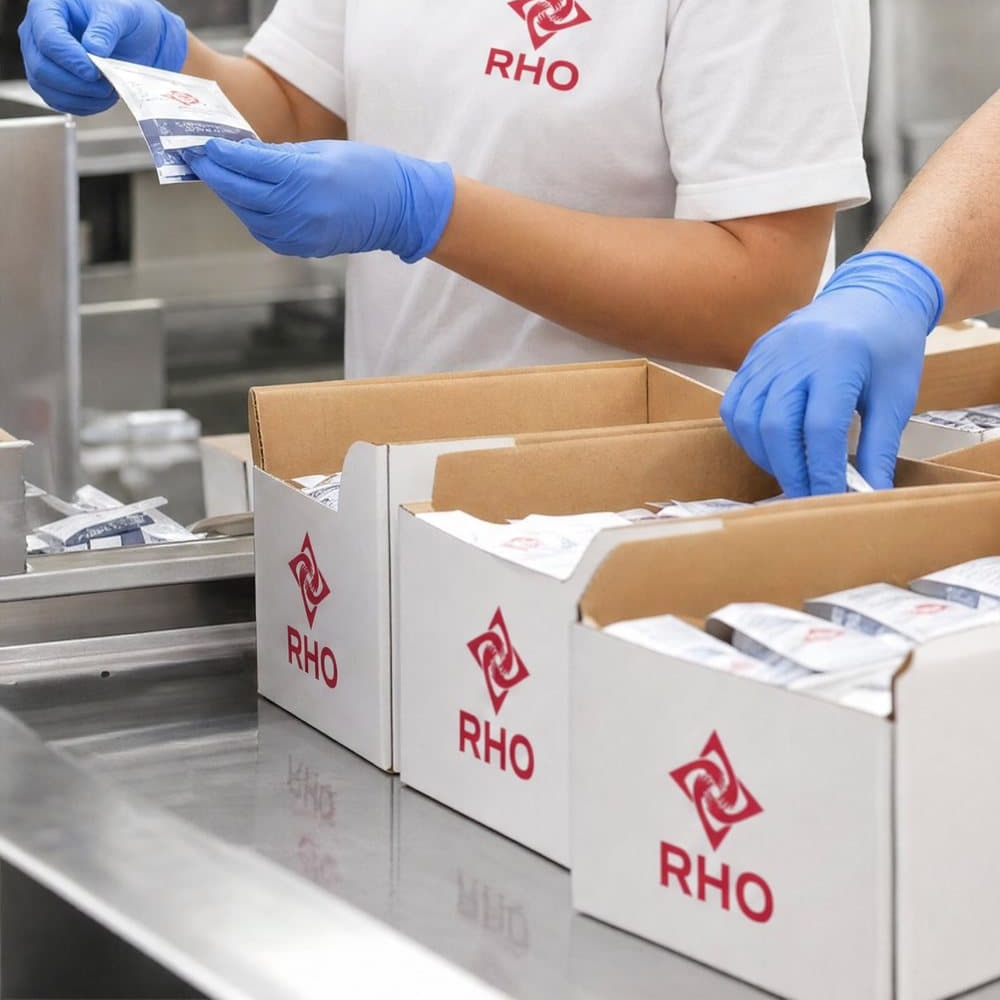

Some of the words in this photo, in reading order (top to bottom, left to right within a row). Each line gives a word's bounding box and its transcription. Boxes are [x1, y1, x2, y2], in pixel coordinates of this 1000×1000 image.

[485, 47, 580, 92] RHO
[287, 626, 338, 689] RHO
[459, 710, 535, 781] RHO
[659, 840, 775, 924] RHO
